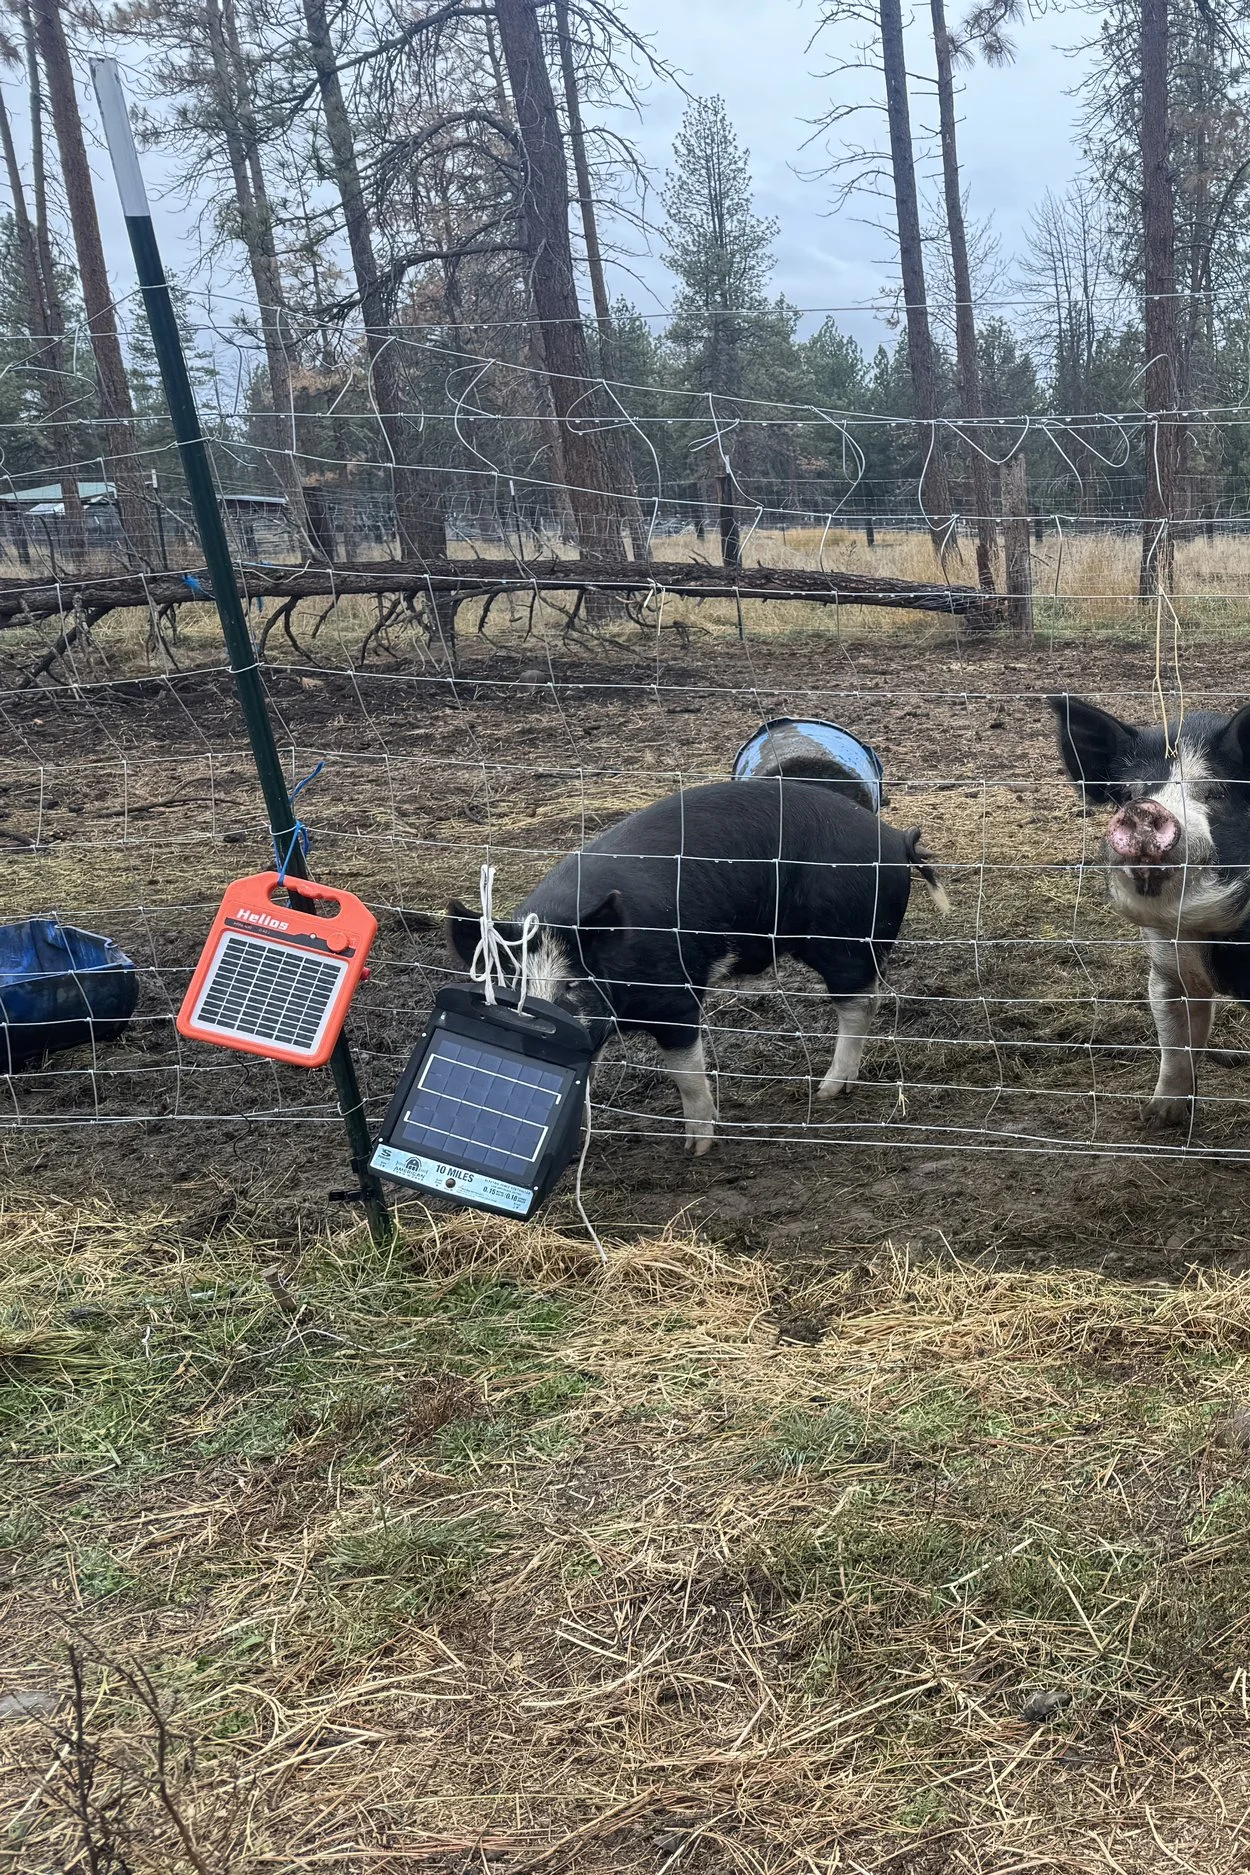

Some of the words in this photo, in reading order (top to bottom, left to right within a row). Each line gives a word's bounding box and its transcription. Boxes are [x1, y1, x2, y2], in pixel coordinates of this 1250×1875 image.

[237, 908, 289, 930] Helios
[394, 1166, 425, 1179] AMERICAN
[435, 1164, 446, 1174] 10
[446, 1168, 474, 1183] MILES
